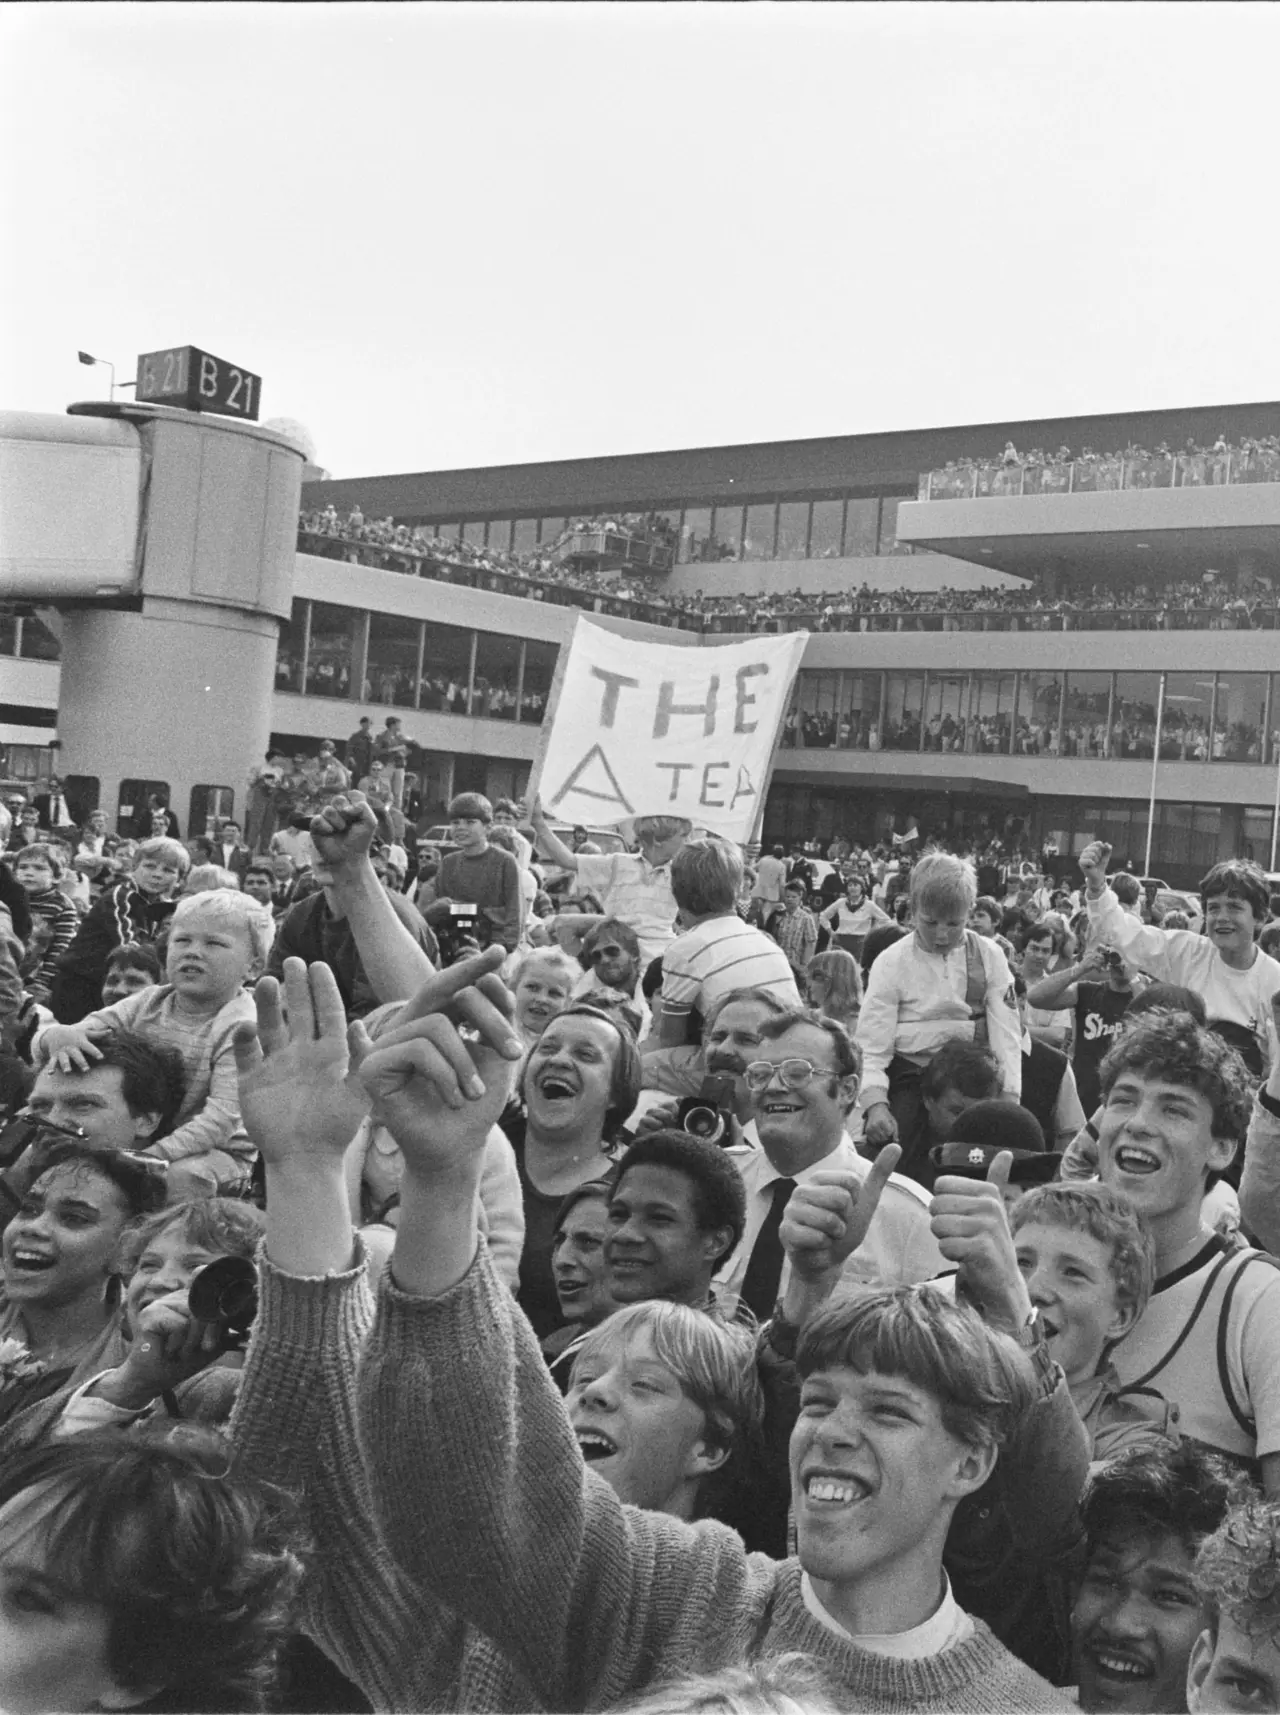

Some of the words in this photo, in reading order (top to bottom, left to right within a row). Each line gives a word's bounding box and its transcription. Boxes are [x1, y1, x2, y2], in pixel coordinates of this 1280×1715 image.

[162, 352, 183, 391] 21
[200, 355, 217, 397] B
[226, 369, 253, 413] 21
[590, 663, 769, 739] THE
[551, 743, 636, 814] A
